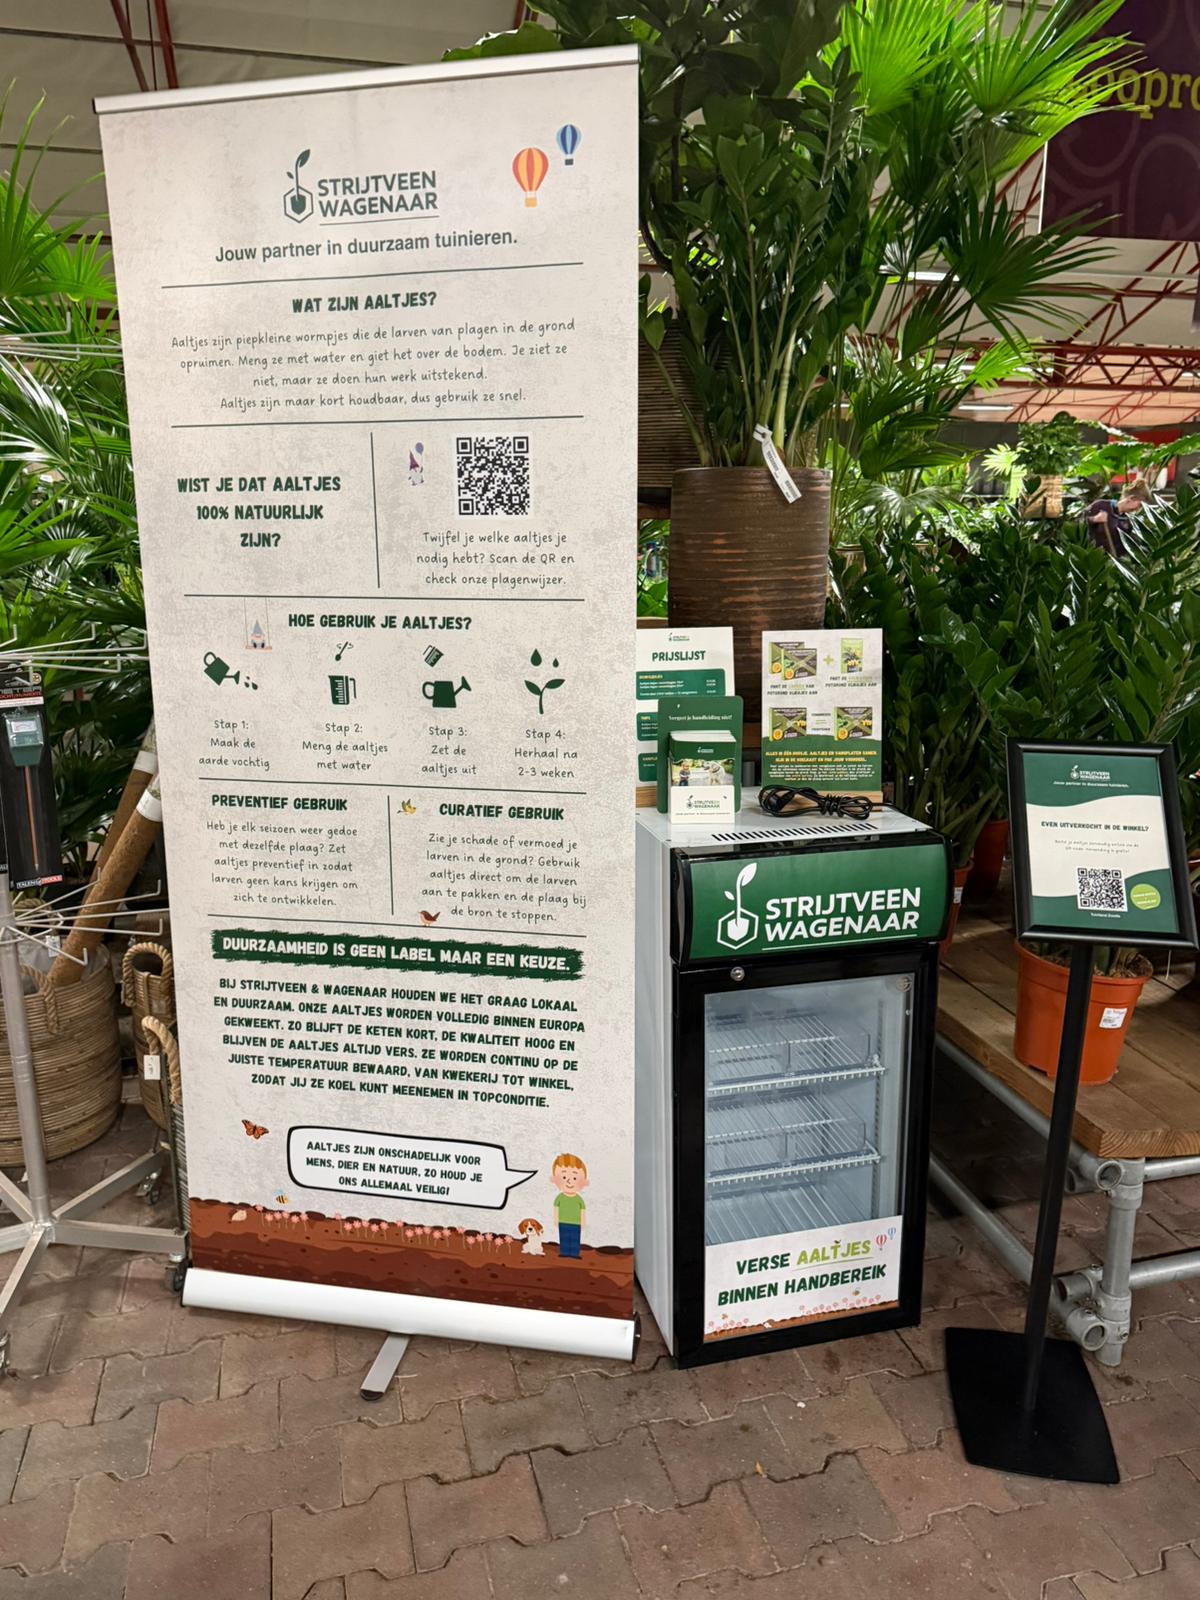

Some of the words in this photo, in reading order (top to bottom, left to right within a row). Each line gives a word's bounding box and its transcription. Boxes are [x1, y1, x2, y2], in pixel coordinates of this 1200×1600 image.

[318, 171, 437, 196] STRIJTVEEN
[319, 192, 438, 218] WAGENAAR
[215, 246, 256, 262] Jouw
[262, 242, 321, 262] partner
[327, 239, 342, 255] in
[347, 236, 429, 254] duurzaam
[435, 231, 517, 248] tuinieren.
[292, 297, 322, 313] WAT
[328, 296, 358, 311] ZIJN
[364, 291, 436, 310] AALTJES?
[171, 335, 208, 351] Aaltjes
[212, 335, 232, 350] zijn
[236, 331, 291, 350] piepkleine
[295, 330, 348, 346] wormpjes
[352, 328, 369, 340] die
[373, 326, 387, 339] de
[391, 325, 427, 337] larven
[431, 327, 453, 336] van
[457, 322, 498, 340] plagen
[502, 322, 514, 333] in
[519, 320, 533, 332] de
[538, 317, 575, 337] grond
[220, 396, 256, 413] Aaltjes
[260, 396, 280, 412] zijn
[285, 398, 315, 406] maar
[320, 393, 344, 406] kort
[348, 391, 406, 405] houdbaar,
[410, 391, 430, 403] dus
[434, 389, 478, 408] gebruik
[483, 393, 494, 401] ze
[499, 388, 525, 401] snel.
[177, 477, 209, 492] WIST
[215, 477, 233, 492] JE
[238, 476, 266, 492] DAT
[272, 476, 340, 491] AALTJES
[196, 505, 229, 519] 100%
[234, 504, 323, 519] NATUURLIJK
[240, 532, 281, 547] ZIJN?
[422, 530, 460, 547] Twijfel
[462, 532, 474, 547] je
[478, 530, 509, 543] welke
[513, 530, 552, 547] aaltjes
[554, 532, 566, 547] je
[416, 551, 448, 568] nodig
[452, 550, 484, 564] hebt?
[489, 553, 517, 564] Scan
[521, 551, 536, 563] de
[540, 553, 555, 565] QR
[560, 555, 574, 563] en
[425, 571, 456, 584] check
[461, 576, 487, 584] onze
[491, 572, 566, 589] plagenwijzer.
[288, 613, 314, 627] HOE
[319, 614, 375, 628] GEBRUIK
[380, 615, 396, 628] JE
[402, 616, 472, 630] AALTJES?
[652, 651, 706, 661] PRIJSLIJST
[214, 719, 237, 733] Stap
[241, 720, 248, 729] 1:
[325, 722, 349, 736] Stap
[353, 723, 362, 732] 2:
[428, 725, 453, 740] Stap
[457, 726, 467, 736] 3:
[210, 736, 239, 748] Maak
[243, 737, 255, 748] de
[525, 728, 550, 743] Stap
[555, 729, 565, 739] 4:
[302, 740, 331, 755] Meng
[335, 740, 348, 751] de
[352, 741, 388, 756] aaltjes
[431, 744, 449, 755] Zet
[453, 744, 466, 755] de
[514, 747, 558, 758] Herhaal
[198, 755, 228, 766] aarde
[232, 756, 269, 771] vochtig
[316, 759, 337, 769] met
[341, 760, 371, 770] water
[421, 762, 457, 777] aaltjes
[462, 764, 476, 774] uit
[518, 766, 536, 776] 2-3
[540, 766, 574, 778] weken
[212, 794, 288, 808] PREVENTIEF
[293, 797, 347, 810] GEBRUIK
[439, 803, 503, 818] CURATIEF
[508, 806, 564, 820] GEBRUIK
[206, 820, 225, 830] Heb
[227, 822, 237, 835] je
[241, 821, 255, 832] elk
[259, 823, 296, 833] seizoen
[327, 825, 357, 839] gedoe
[765, 887, 921, 920] STRIJTVEEN
[765, 911, 920, 942] WAGENAAR
[223, 937, 328, 955] DUURZAAMHEID
[333, 943, 345, 956] IS
[350, 944, 385, 958] GEEN
[390, 946, 435, 961] LABEL
[440, 949, 481, 964] MAAR
[486, 952, 514, 966] EEN
[520, 954, 569, 970] KEUZE.
[219, 978, 236, 989] BIJ
[240, 979, 306, 993] STRIJTVEEN
[311, 983, 319, 993] &
[323, 984, 387, 997] WAGENAAR
[391, 988, 435, 1001] HOUDEN
[439, 991, 456, 1002] WE
[460, 993, 483, 1004] HET
[487, 995, 527, 1008] GRAAG
[531, 998, 577, 1012] LOKAAL
[214, 996, 227, 1007] EN
[231, 997, 294, 1011] DUURZAAM.
[298, 1002, 327, 1013] ONZE
[331, 1004, 382, 1017] AALTJES
[386, 1007, 432, 1020] WORDEN
[436, 1010, 489, 1024] VOLLEDIG
[493, 1015, 535, 1028] BINNEN
[539, 1018, 585, 1032] EUROPA
[306, 1141, 350, 1153] AALTJES
[353, 1145, 375, 1156] ZIJN
[378, 1147, 451, 1162] ONSCHADELIJK
[454, 1154, 480, 1165] VOOR
[306, 1157, 334, 1168] MENS,
[337, 1160, 359, 1170] DIER
[362, 1162, 375, 1172] EN
[379, 1164, 420, 1177] NATUUR,
[424, 1168, 436, 1178] ZO
[440, 1169, 466, 1180] HOUD
[470, 1172, 482, 1182] JE
[338, 1176, 357, 1186] ONS
[360, 1178, 412, 1191] ALLEMAAL
[415, 1183, 449, 1195] VEILIG!
[736, 1253, 790, 1275] VERSE
[796, 1240, 871, 1265] AALTJES
[718, 1282, 778, 1306] BINNEN
[784, 1264, 886, 1294] HANDBEREIK
